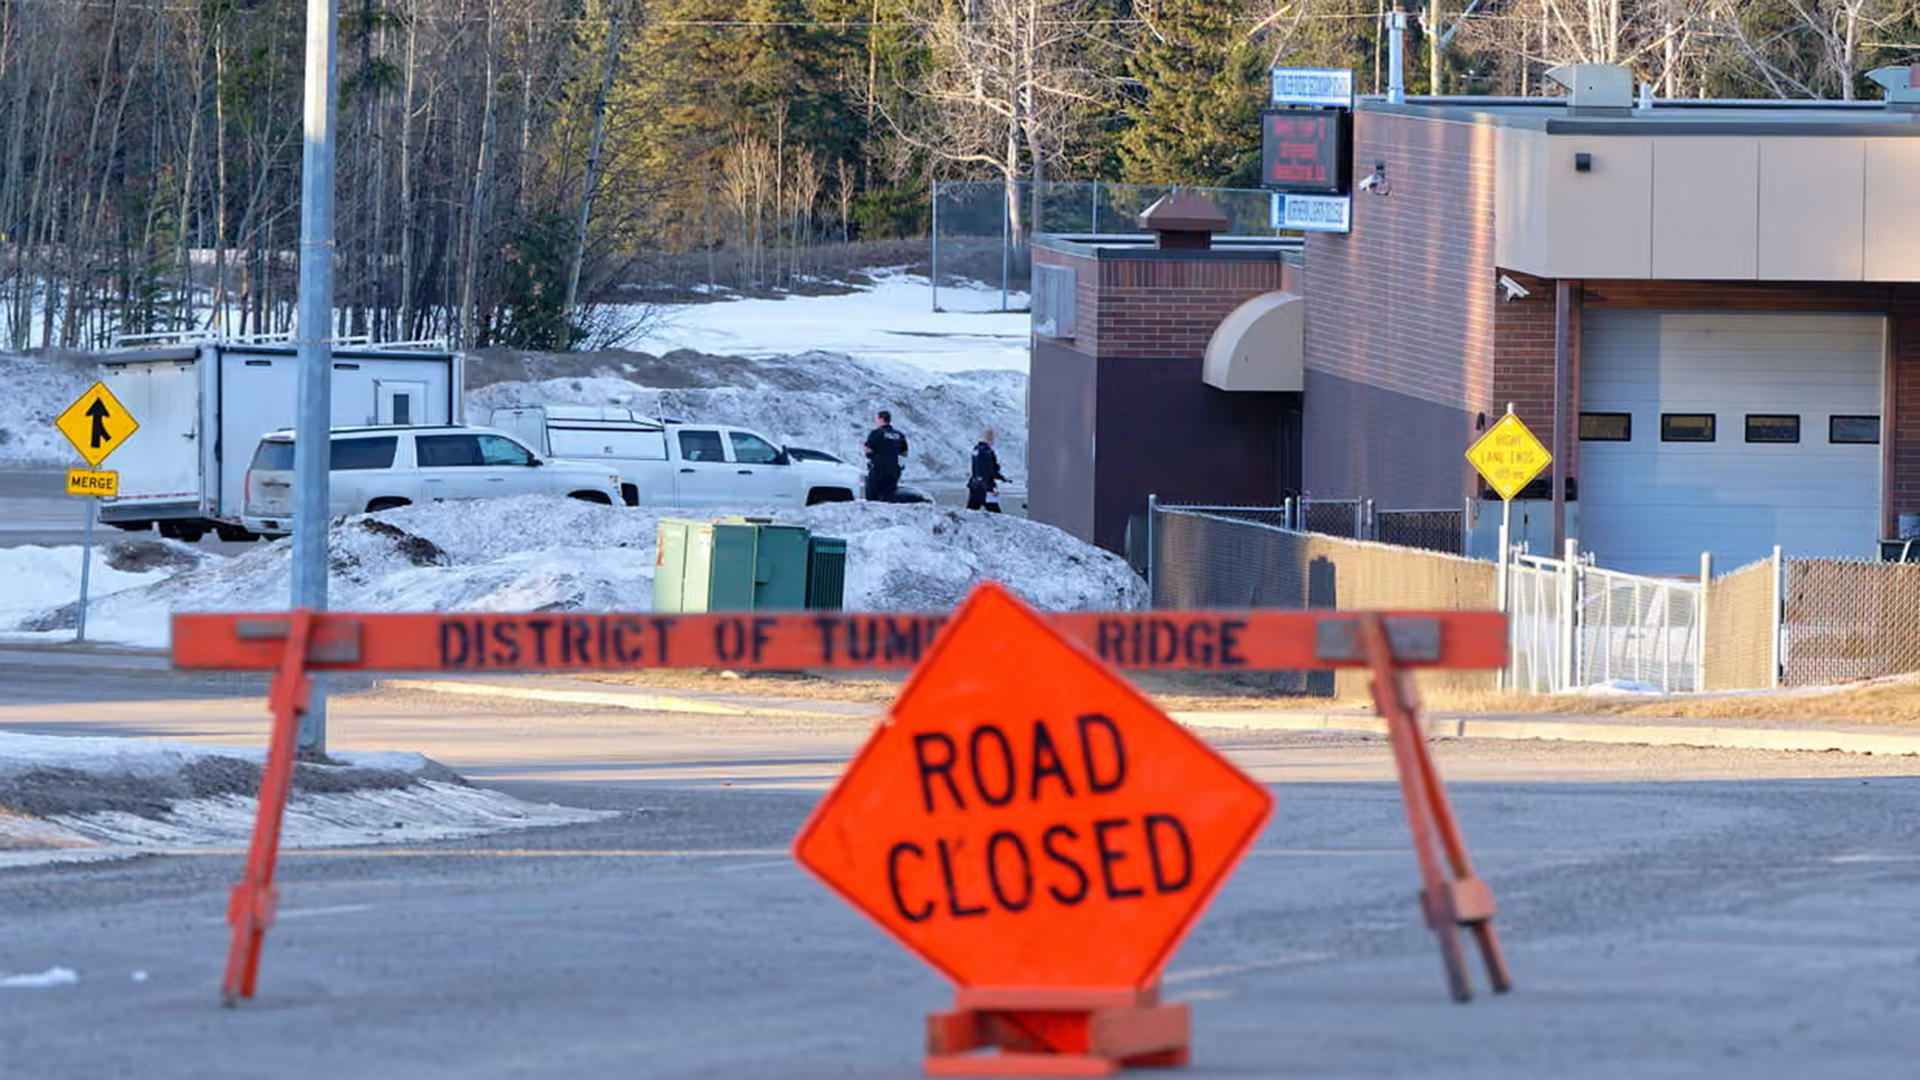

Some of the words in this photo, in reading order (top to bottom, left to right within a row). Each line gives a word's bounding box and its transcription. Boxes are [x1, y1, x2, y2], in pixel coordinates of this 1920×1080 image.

[71, 476, 113, 489] MERGE
[440, 619, 677, 663] DISTRICT
[713, 617, 777, 663] OF
[1098, 619, 1247, 664] RIDGE
[913, 713, 1127, 813] ROAD
[887, 813, 1194, 923] CLOSED
